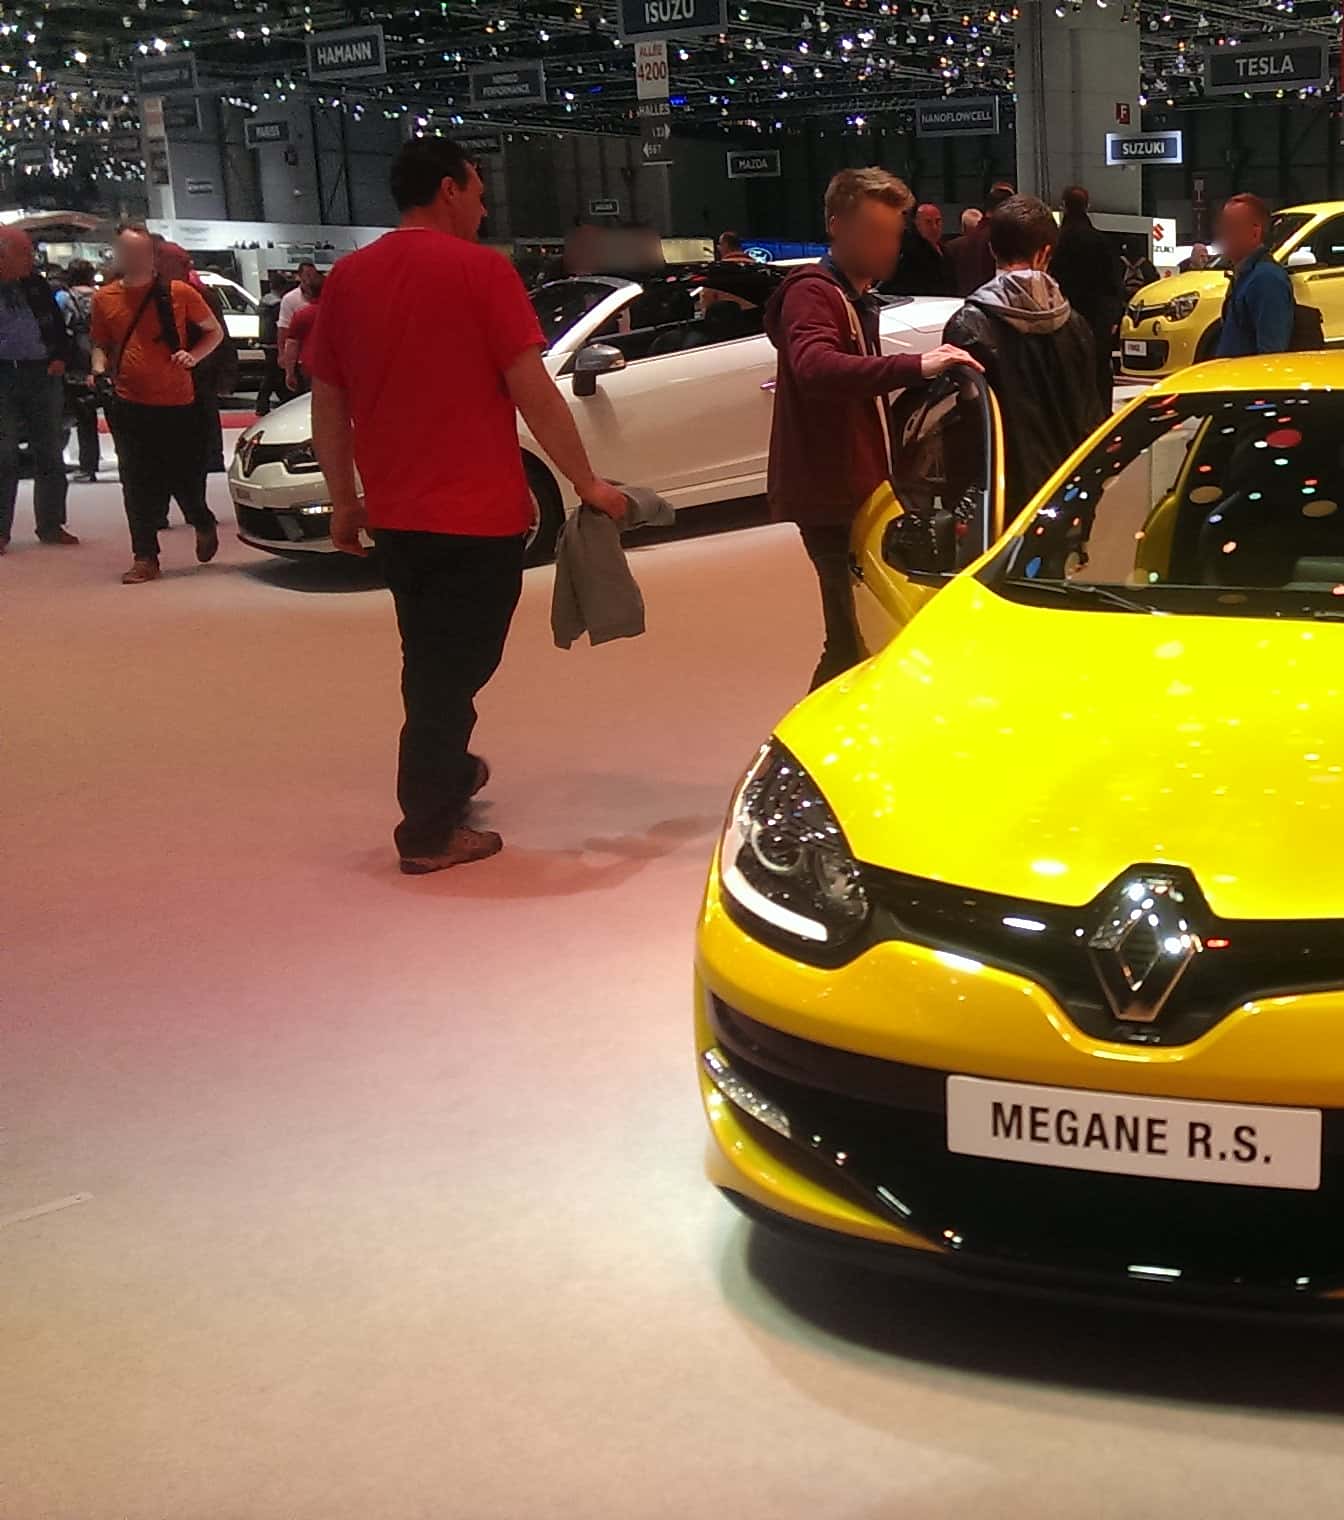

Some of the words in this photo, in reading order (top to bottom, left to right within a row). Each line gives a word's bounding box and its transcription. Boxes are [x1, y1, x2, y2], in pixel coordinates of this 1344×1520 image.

[645, 0, 694, 24] ISUZU
[317, 41, 371, 64] HAMANN
[638, 61, 666, 80] 4200
[1235, 55, 1294, 76] TESLA
[921, 111, 992, 123] NANOFLOWCELL
[1120, 105, 1128, 119] F
[1122, 142, 1165, 155] SUZUKI
[739, 158, 768, 169] MAZDA
[991, 1101, 1168, 1155] MEGANE
[1187, 1121, 1272, 1164] R.S.
